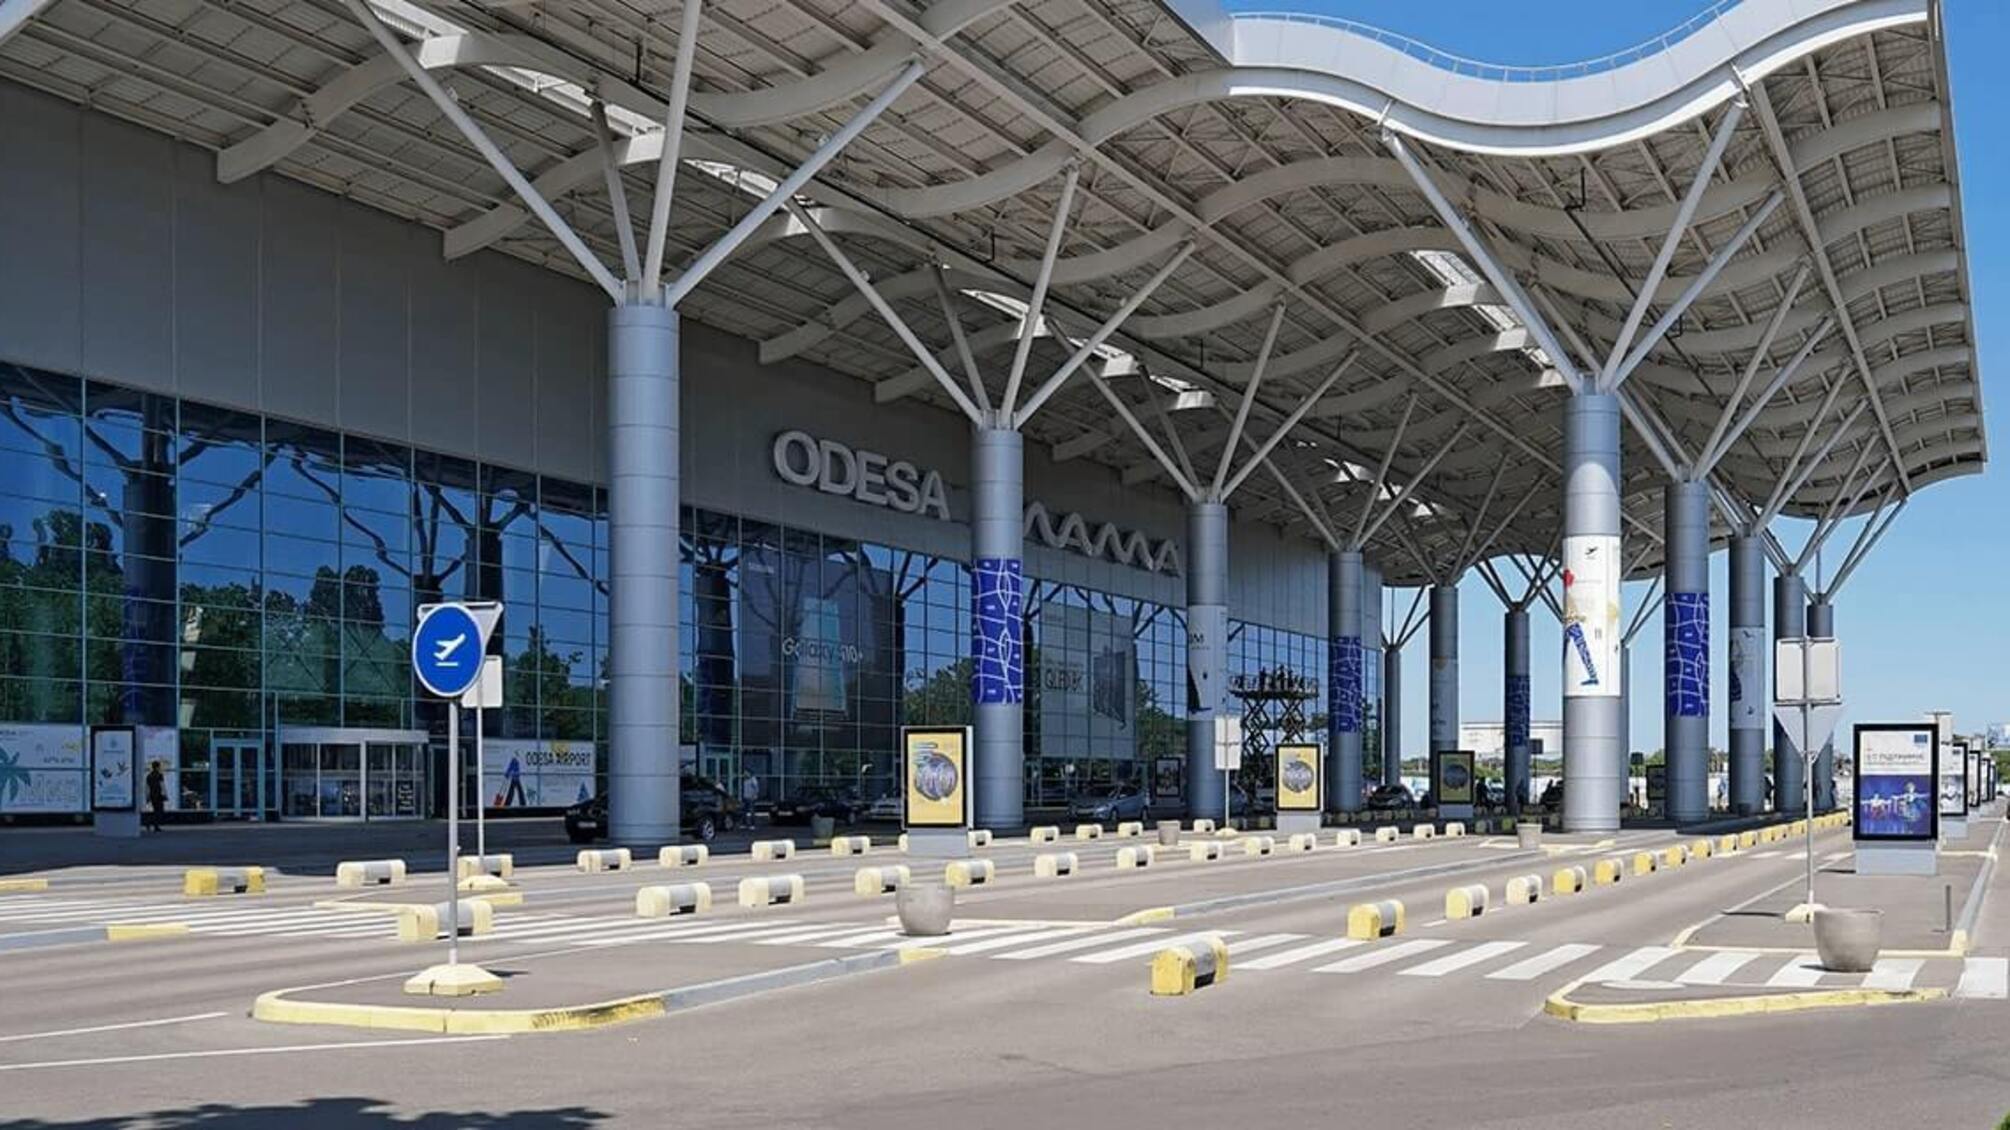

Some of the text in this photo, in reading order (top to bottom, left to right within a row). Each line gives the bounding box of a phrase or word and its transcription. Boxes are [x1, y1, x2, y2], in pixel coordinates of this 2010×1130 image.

[772, 429, 951, 521] ODESA
[782, 636, 835, 666] Galaxy
[526, 751, 591, 767] ODESA AIRPORT
